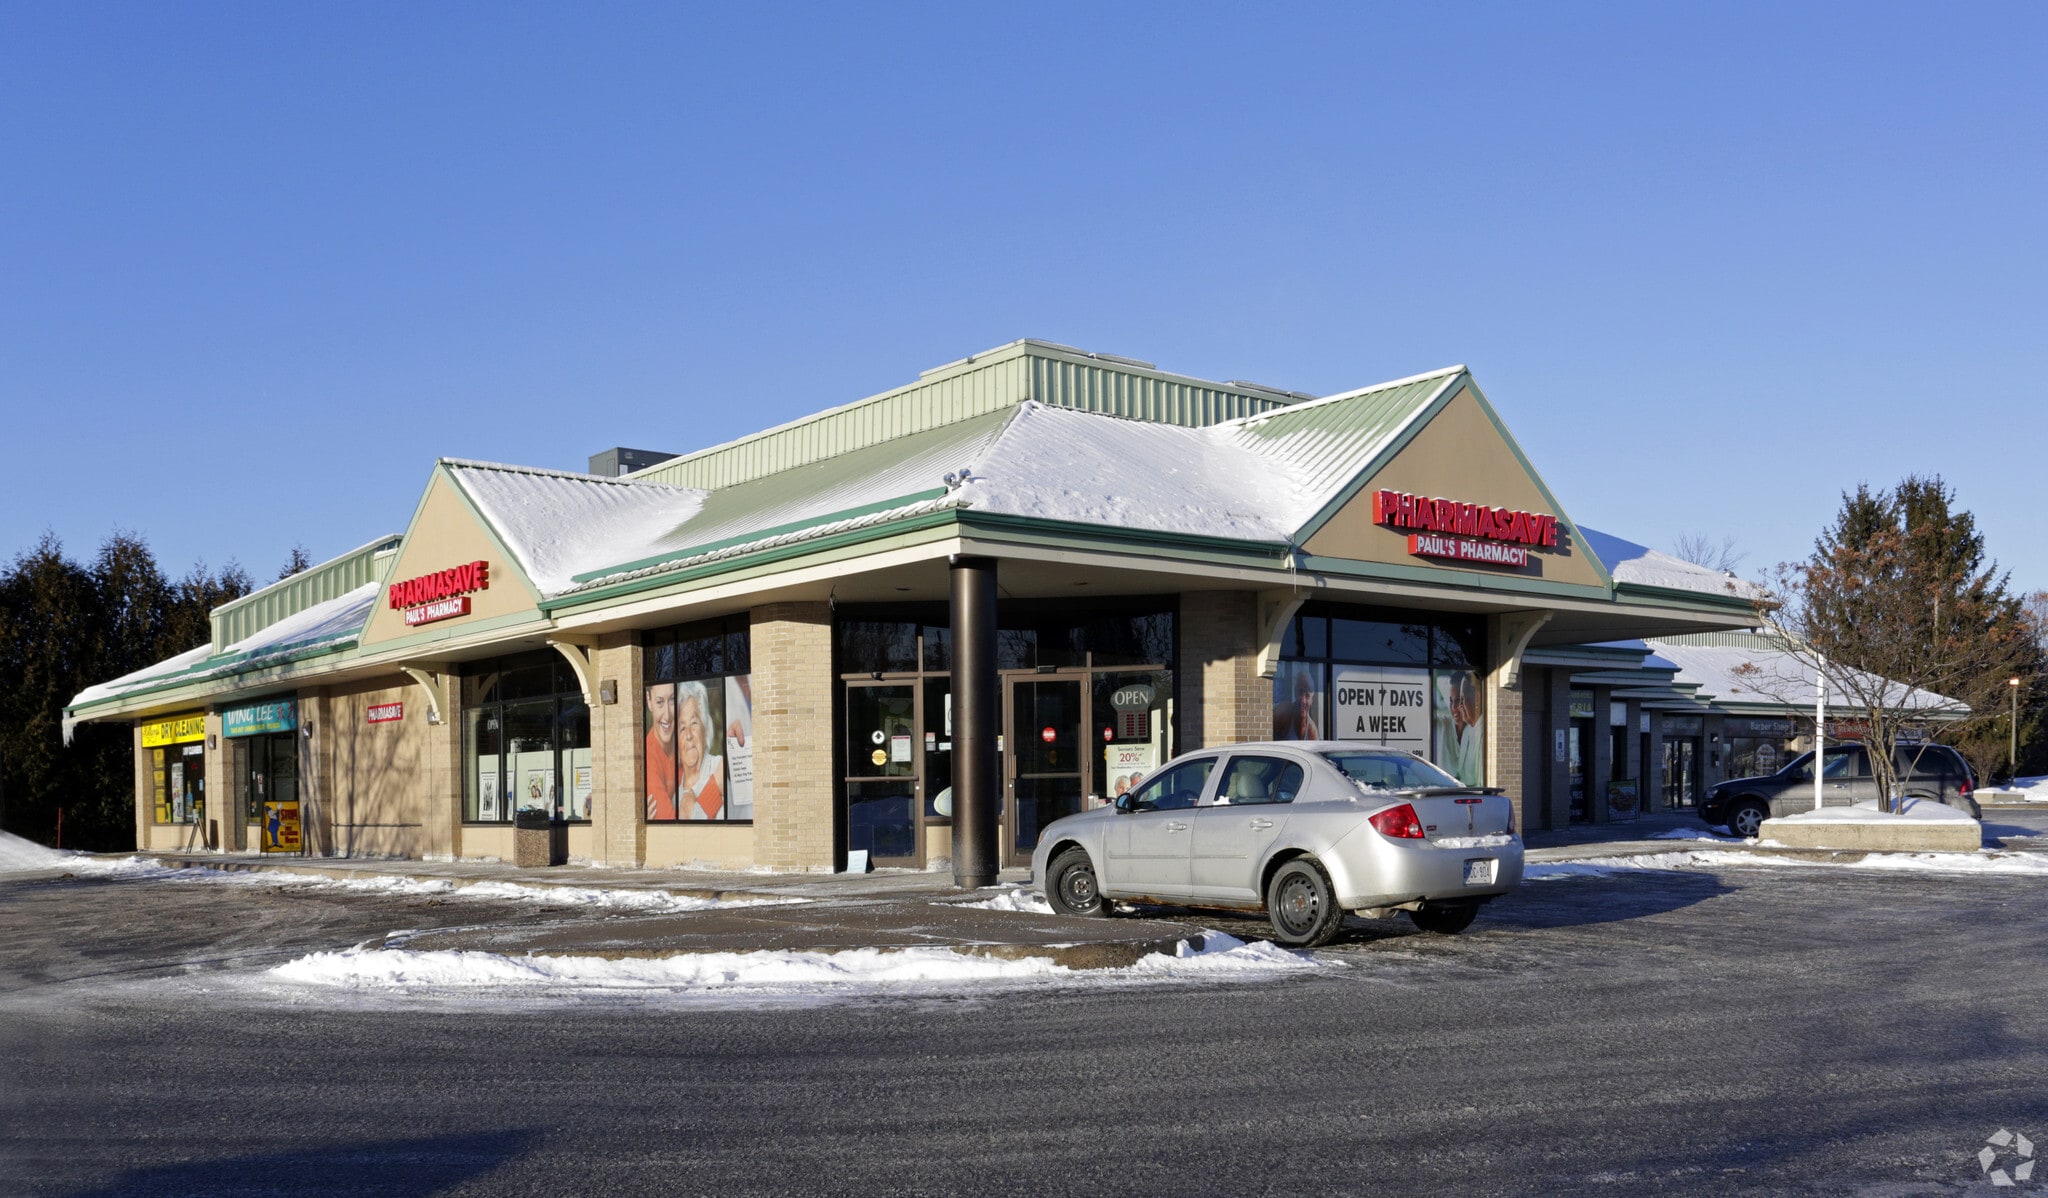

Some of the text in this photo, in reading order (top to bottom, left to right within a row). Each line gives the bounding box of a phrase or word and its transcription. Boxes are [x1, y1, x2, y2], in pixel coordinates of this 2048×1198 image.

[1375, 490, 1557, 547] PHARMASAVE
[1417, 536, 1525, 565] PAUL'S PHARMACY
[390, 561, 486, 610] PHARMASAVE
[405, 598, 463, 624] PAUL'S PHARMACY
[1114, 690, 1149, 706] OPEN
[1338, 687, 1424, 707] OPEN 7 DAYS
[227, 702, 274, 726] WING LEE
[1356, 715, 1407, 733] A WEEK
[160, 721, 173, 740] DRY
[175, 717, 205, 738] CLEANING
[1750, 721, 1772, 731] Barber
[1119, 752, 1140, 763] 20%
